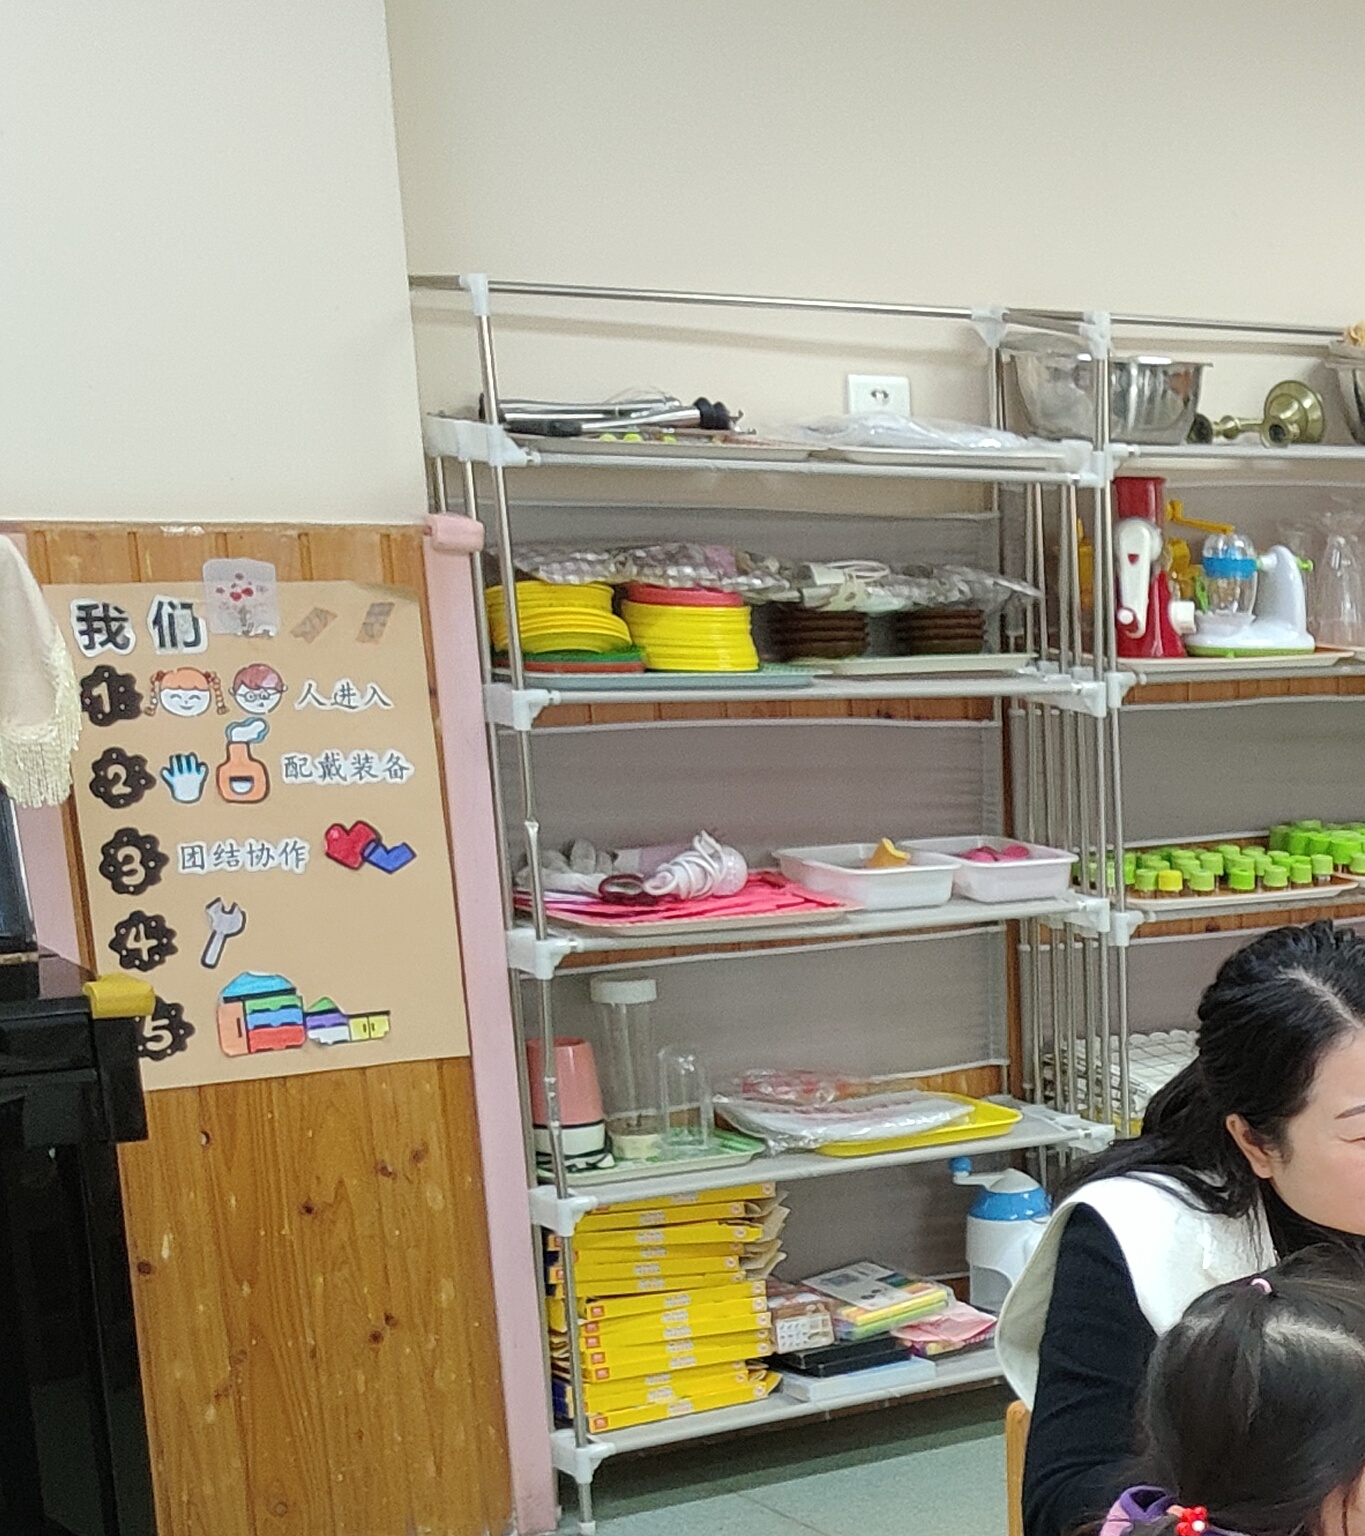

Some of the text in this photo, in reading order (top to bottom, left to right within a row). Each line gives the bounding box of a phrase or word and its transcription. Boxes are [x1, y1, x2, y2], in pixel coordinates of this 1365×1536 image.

[75, 600, 202, 652] 我们
[297, 682, 393, 710] 人进入
[107, 753, 411, 795] 2 配戴装备
[120, 842, 309, 886] 3 团结协作
[128, 924, 159, 958] 4
[141, 1017, 174, 1052] 5
